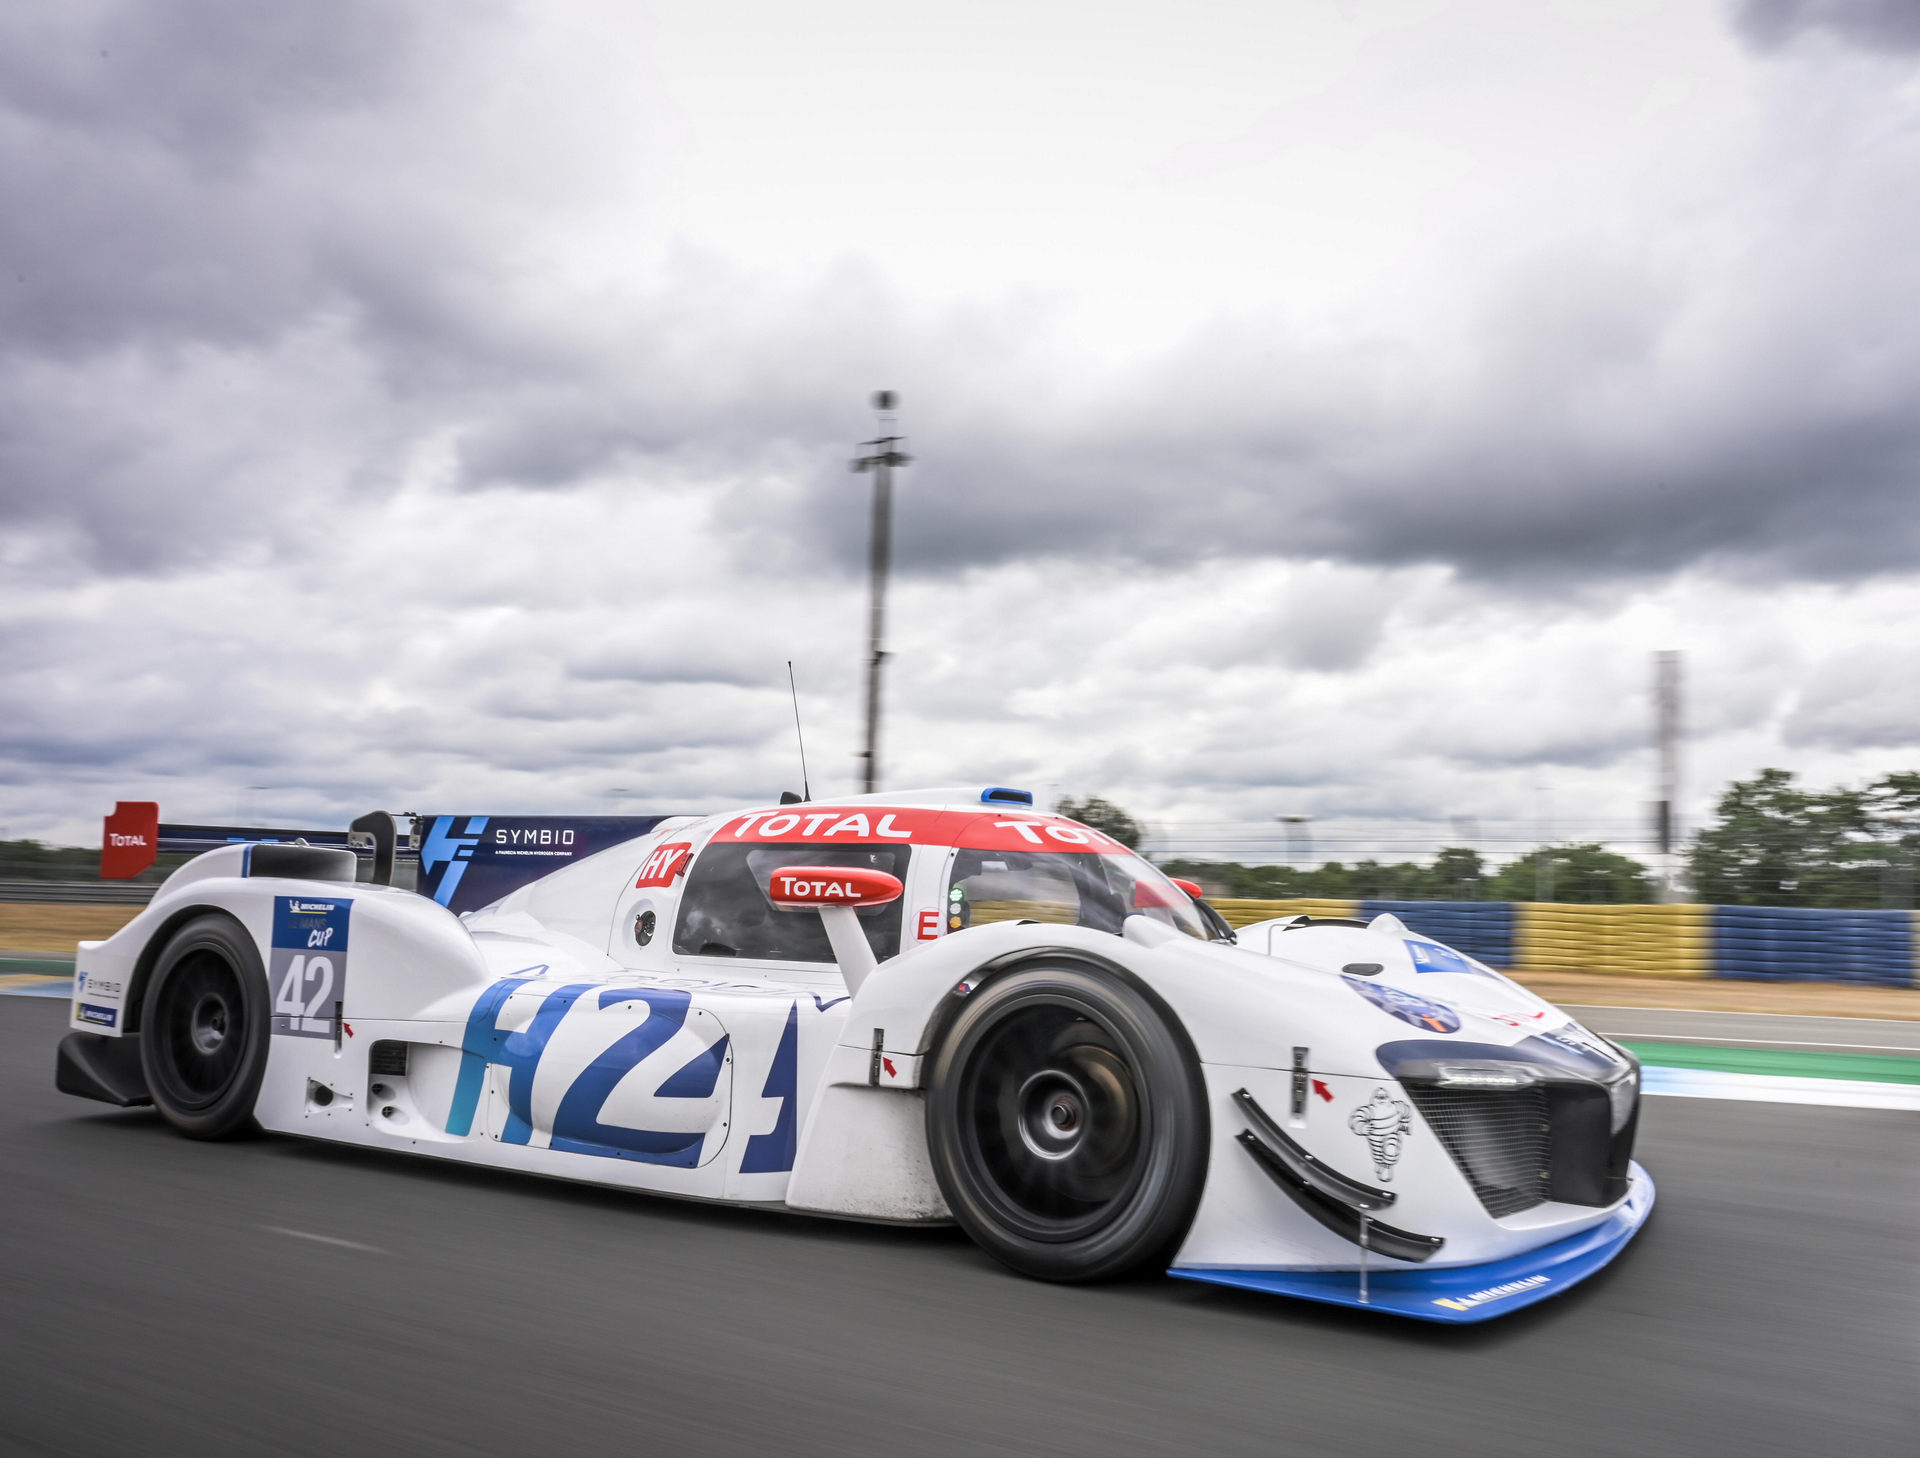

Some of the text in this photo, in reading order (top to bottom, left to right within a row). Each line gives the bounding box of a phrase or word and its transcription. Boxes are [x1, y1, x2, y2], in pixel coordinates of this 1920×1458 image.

[495, 829, 574, 845] SYMBIO
[734, 811, 912, 838] TOTAL
[993, 820, 1110, 846] TOT
[109, 833, 148, 847] TOTAL
[640, 848, 686, 880] HY
[780, 876, 861, 898] TOTAL
[300, 903, 335, 911] MICHELIN
[307, 927, 334, 948] CUP
[917, 911, 940, 941] E
[275, 954, 334, 1034] 42
[446, 977, 799, 1174] H24
